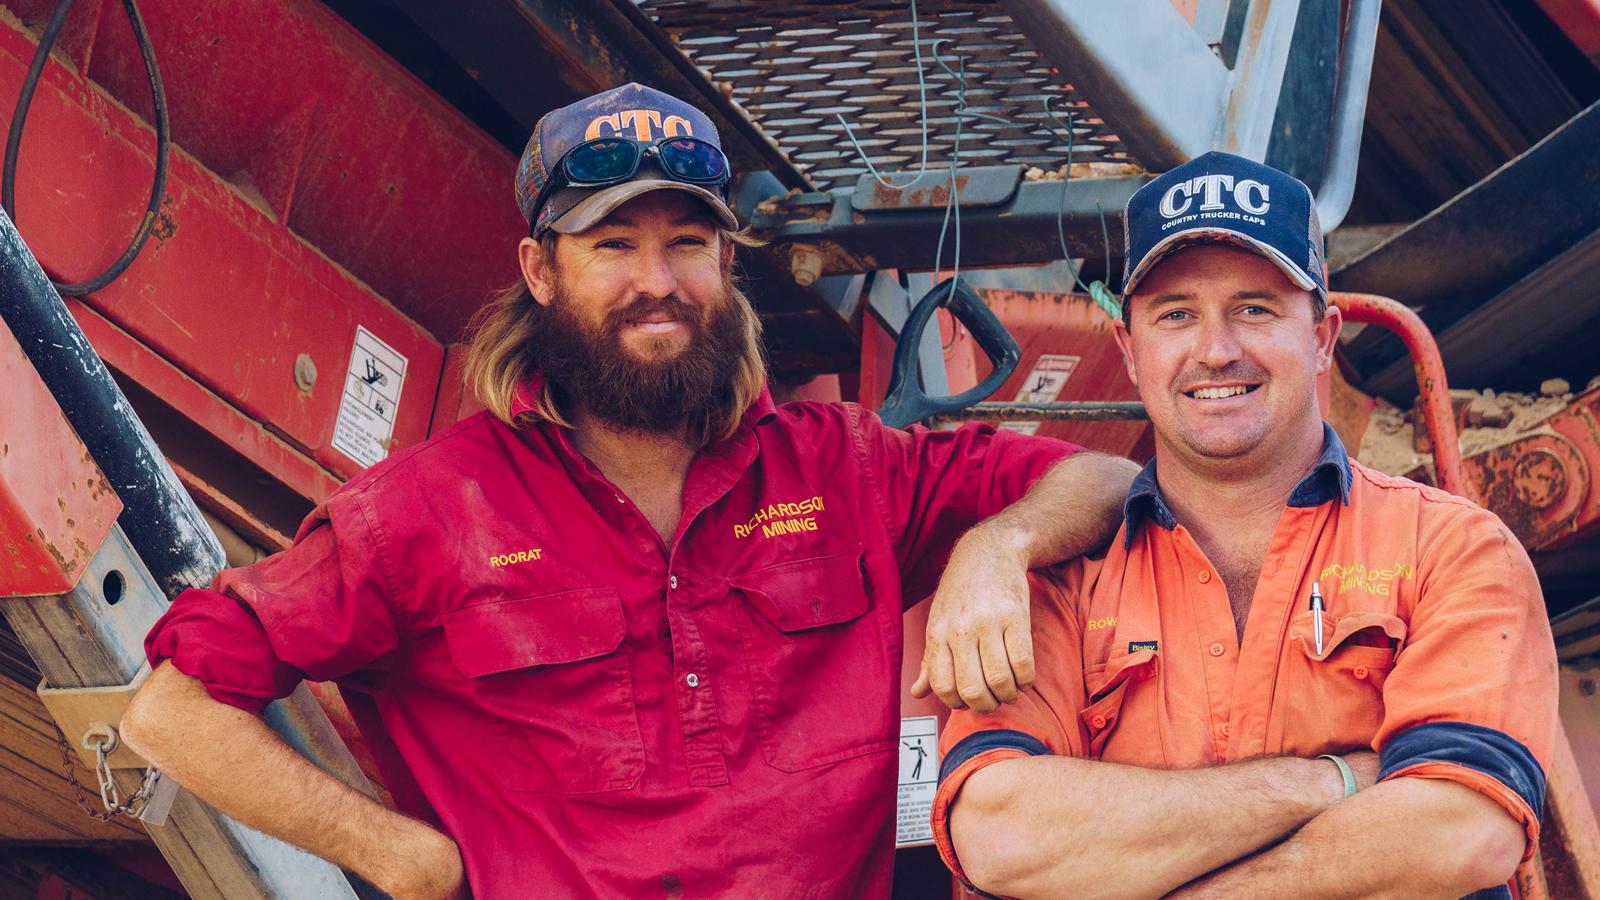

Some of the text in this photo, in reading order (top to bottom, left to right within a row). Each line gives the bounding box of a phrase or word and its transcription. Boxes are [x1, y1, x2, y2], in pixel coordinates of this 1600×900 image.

[585, 109, 693, 142] CTC
[1160, 174, 1270, 218] CTC
[1161, 211, 1266, 230] COUNTRY TRUCKER CAPS
[762, 517, 818, 539] MINING
[490, 548, 542, 567] ROORAT
